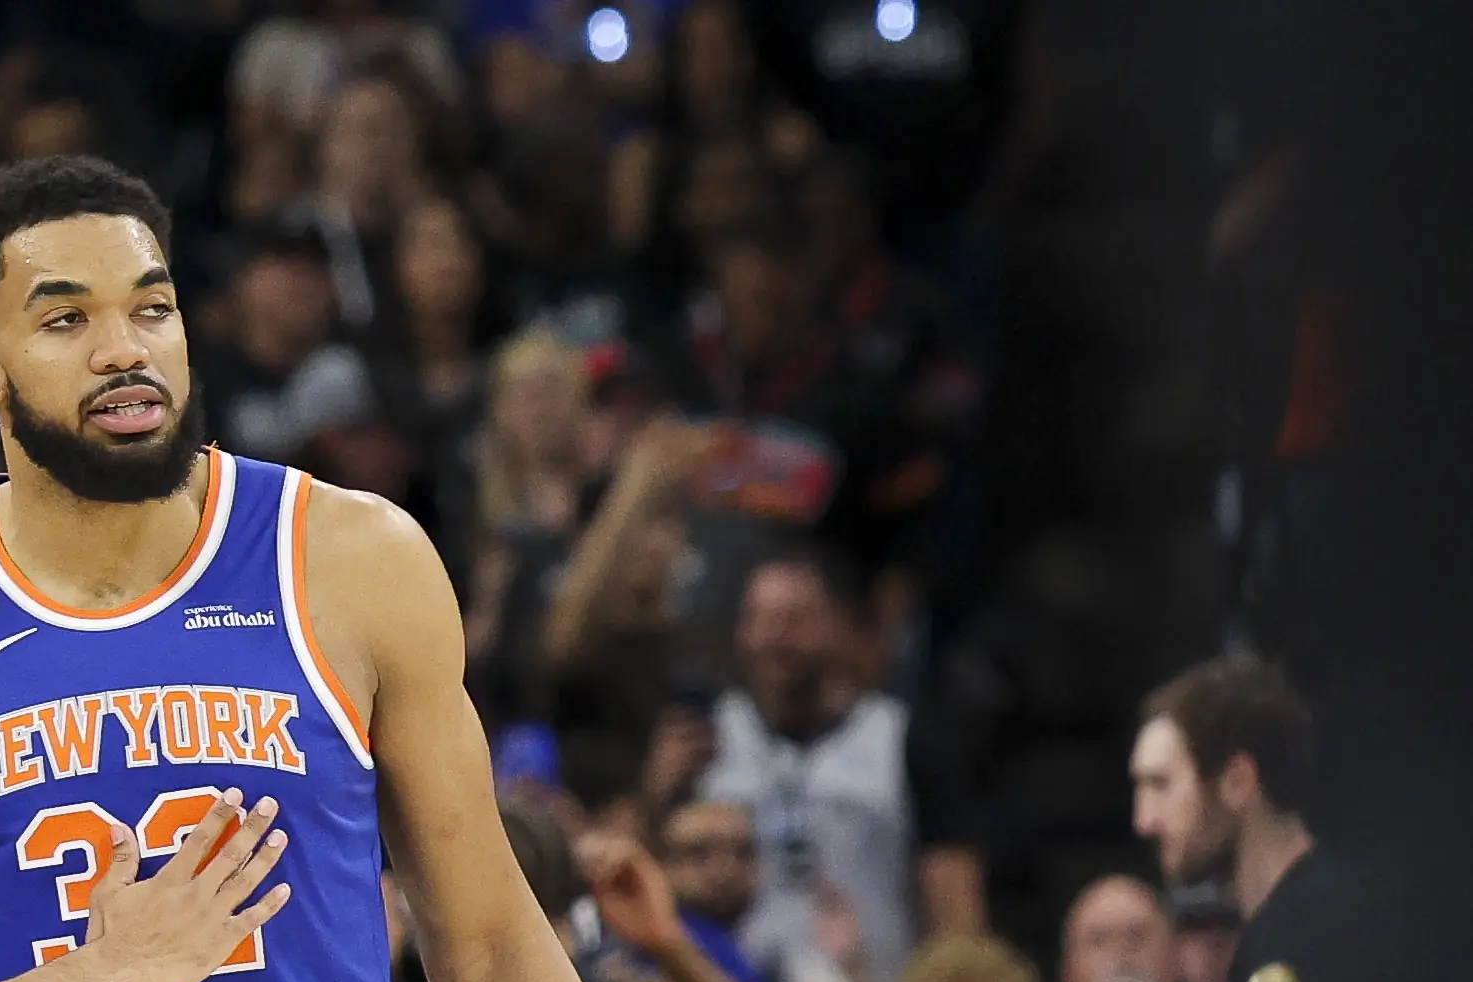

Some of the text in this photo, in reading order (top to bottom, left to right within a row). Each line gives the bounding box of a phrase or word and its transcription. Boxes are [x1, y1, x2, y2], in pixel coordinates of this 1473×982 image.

[183, 605, 233, 615] experience
[185, 610, 275, 630] abu dhabi
[106, 684, 307, 776] YORK
